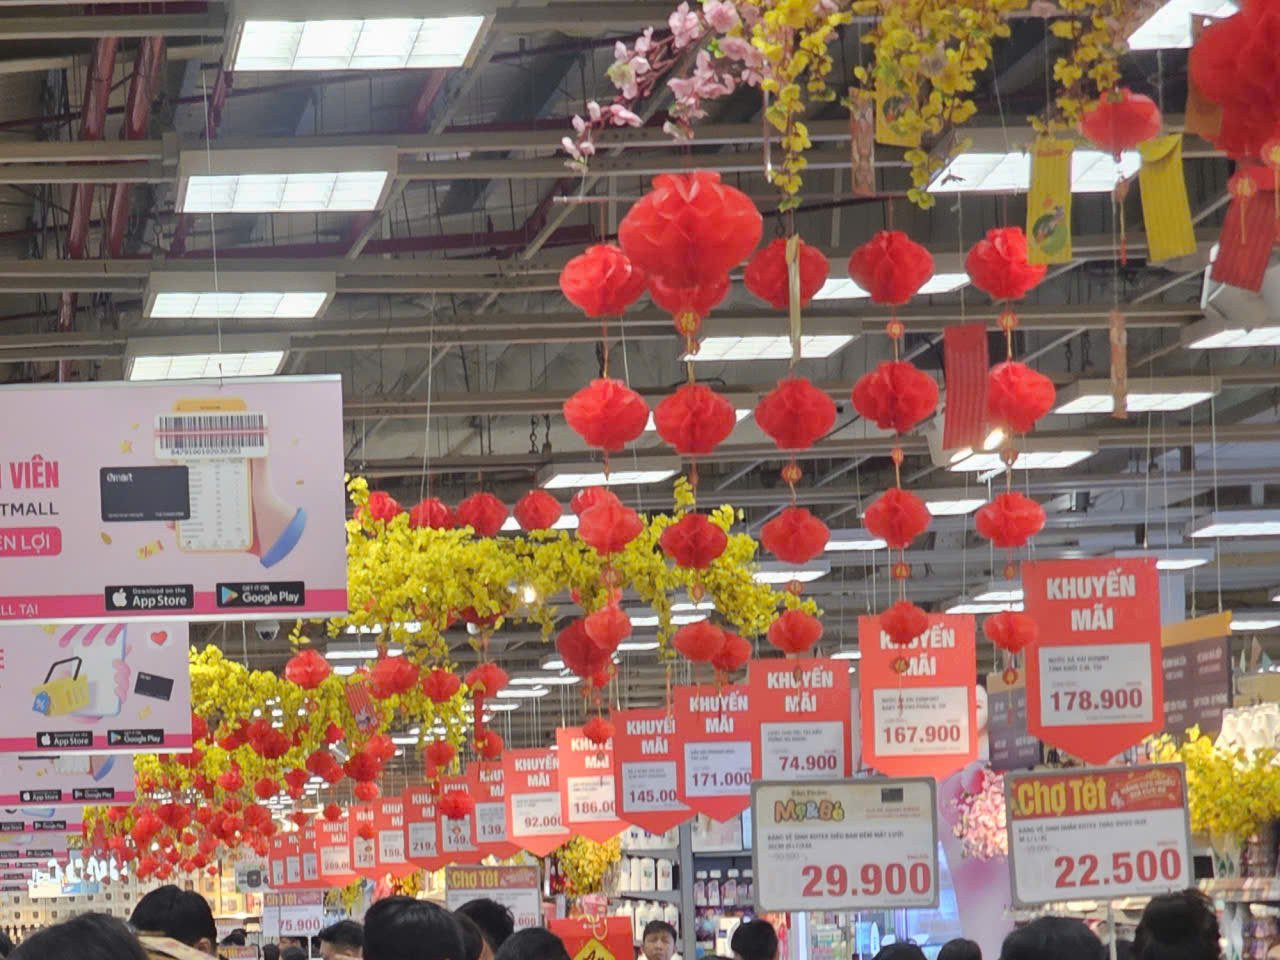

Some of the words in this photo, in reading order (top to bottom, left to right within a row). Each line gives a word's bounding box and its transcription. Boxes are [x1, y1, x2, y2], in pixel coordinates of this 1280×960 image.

[8, 453, 60, 489] VIÊN
[21, 533, 51, 554] LỢI
[1046, 568, 1136, 600] KHUYẾN
[132, 595, 156, 609] App
[157, 594, 187, 606] Store
[242, 592, 278, 605] Google
[279, 591, 299, 604] Play
[18, 602, 39, 619] TẠI
[1071, 603, 1115, 632] MÃI
[768, 665, 834, 690] KHUYẾN
[689, 690, 749, 713] KHUYẾN
[784, 692, 817, 713] MÃI
[1050, 687, 1143, 713] 178.900
[705, 714, 735, 734] MÃI
[53, 736, 69, 746] App
[70, 736, 89, 745] Store
[148, 734, 161, 744] Play
[883, 725, 961, 745] 167.900
[641, 738, 669, 755] MÃI
[779, 754, 838, 772] 74.900
[527, 772, 551, 787] MÃI
[692, 772, 753, 787] 171.000
[629, 789, 677, 804] 145.00
[1054, 847, 1182, 889] 22.500
[801, 861, 932, 897] 29.900
